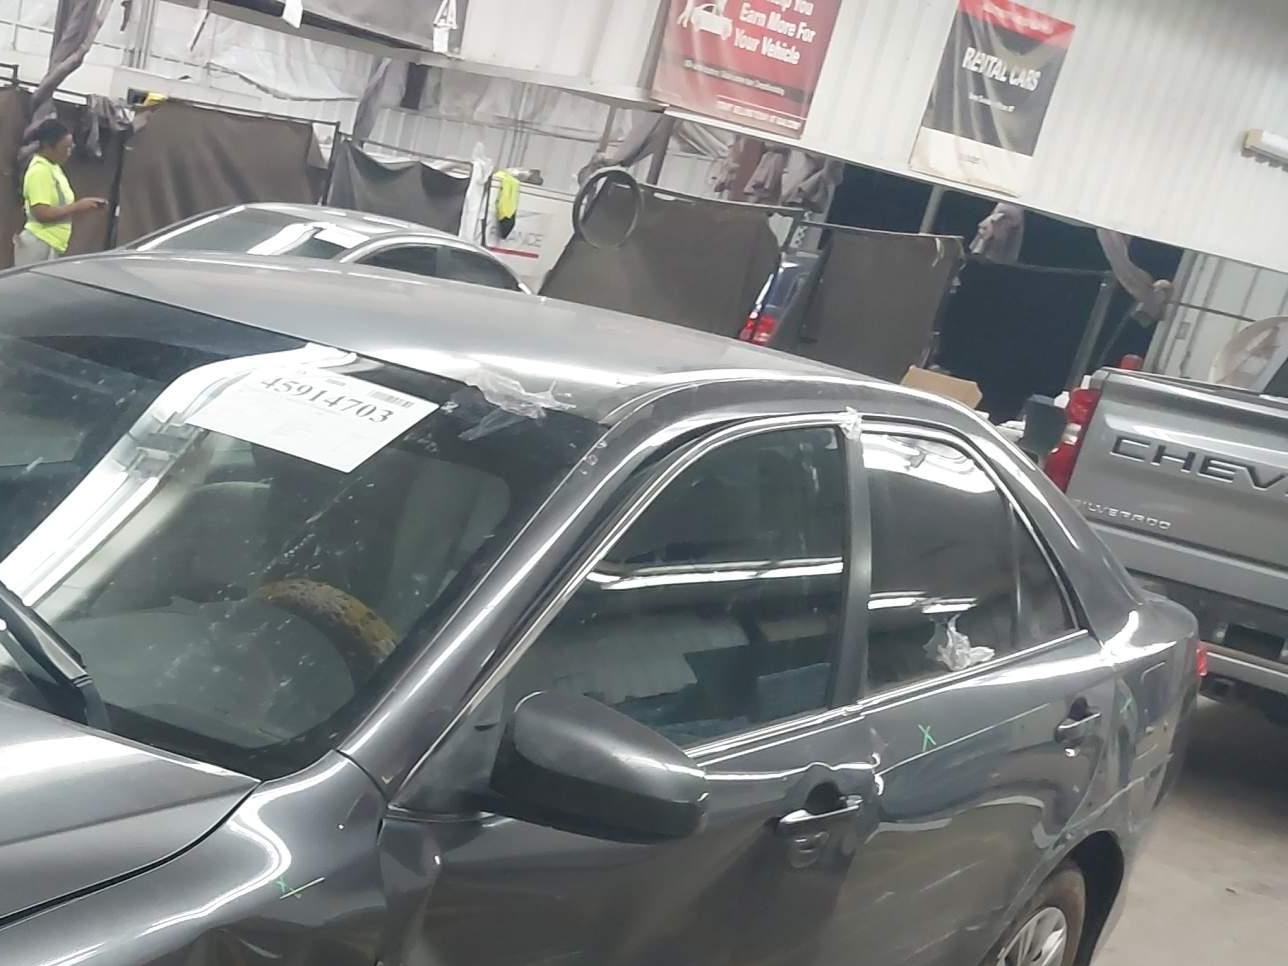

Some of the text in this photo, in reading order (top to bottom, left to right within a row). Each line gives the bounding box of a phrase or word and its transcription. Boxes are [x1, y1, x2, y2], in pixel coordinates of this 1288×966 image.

[739, 2, 767, 28] Earn
[766, 11, 797, 37] More
[796, 22, 816, 43] For
[734, 28, 801, 65] Your Vehicle
[962, 47, 1041, 92] RENTAL CARS
[261, 377, 394, 423] 45914703
[1109, 436, 1288, 496] CHEV
